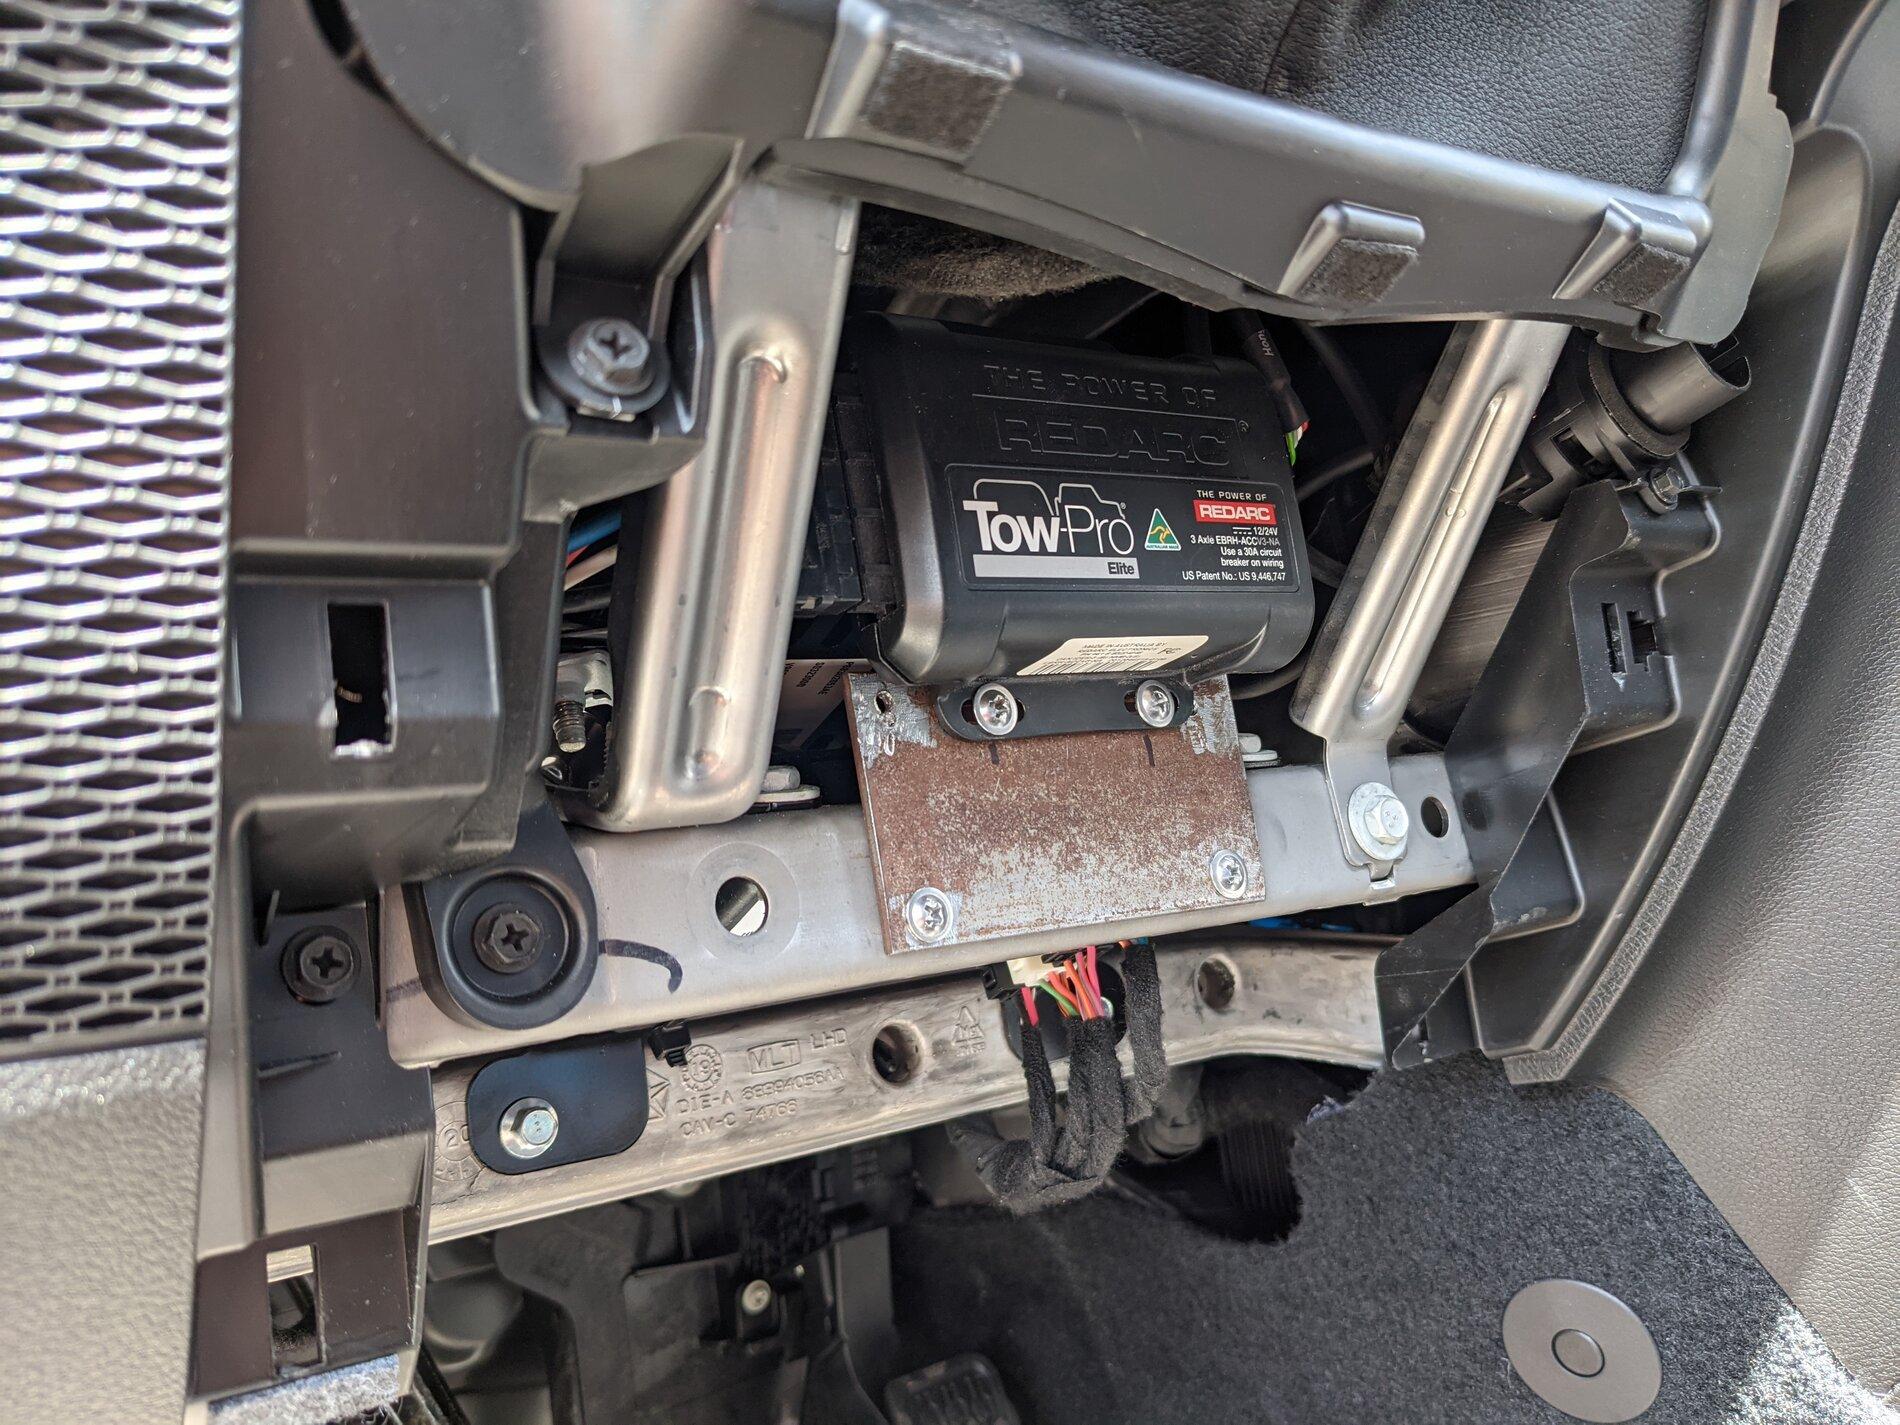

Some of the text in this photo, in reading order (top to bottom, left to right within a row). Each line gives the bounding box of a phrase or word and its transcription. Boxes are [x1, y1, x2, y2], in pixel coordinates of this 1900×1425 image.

[983, 365, 1216, 405] THE POWER OF
[993, 411, 1230, 466] REDARC
[1196, 490, 1267, 501] THE POWER OF
[1199, 504, 1271, 521] REDARC
[1253, 526, 1278, 536] 12/24V
[1190, 535, 1281, 546] 3 Axle EBRH-ACCV3-NA
[1220, 547, 1236, 556] Use
[1243, 547, 1259, 556] 30A
[1260, 547, 1282, 557] circuit
[1107, 561, 1135, 575] Elite
[1220, 557, 1284, 569] breaker on wiring
[1182, 571, 1286, 582] US Patent No.: US 9,446,747
